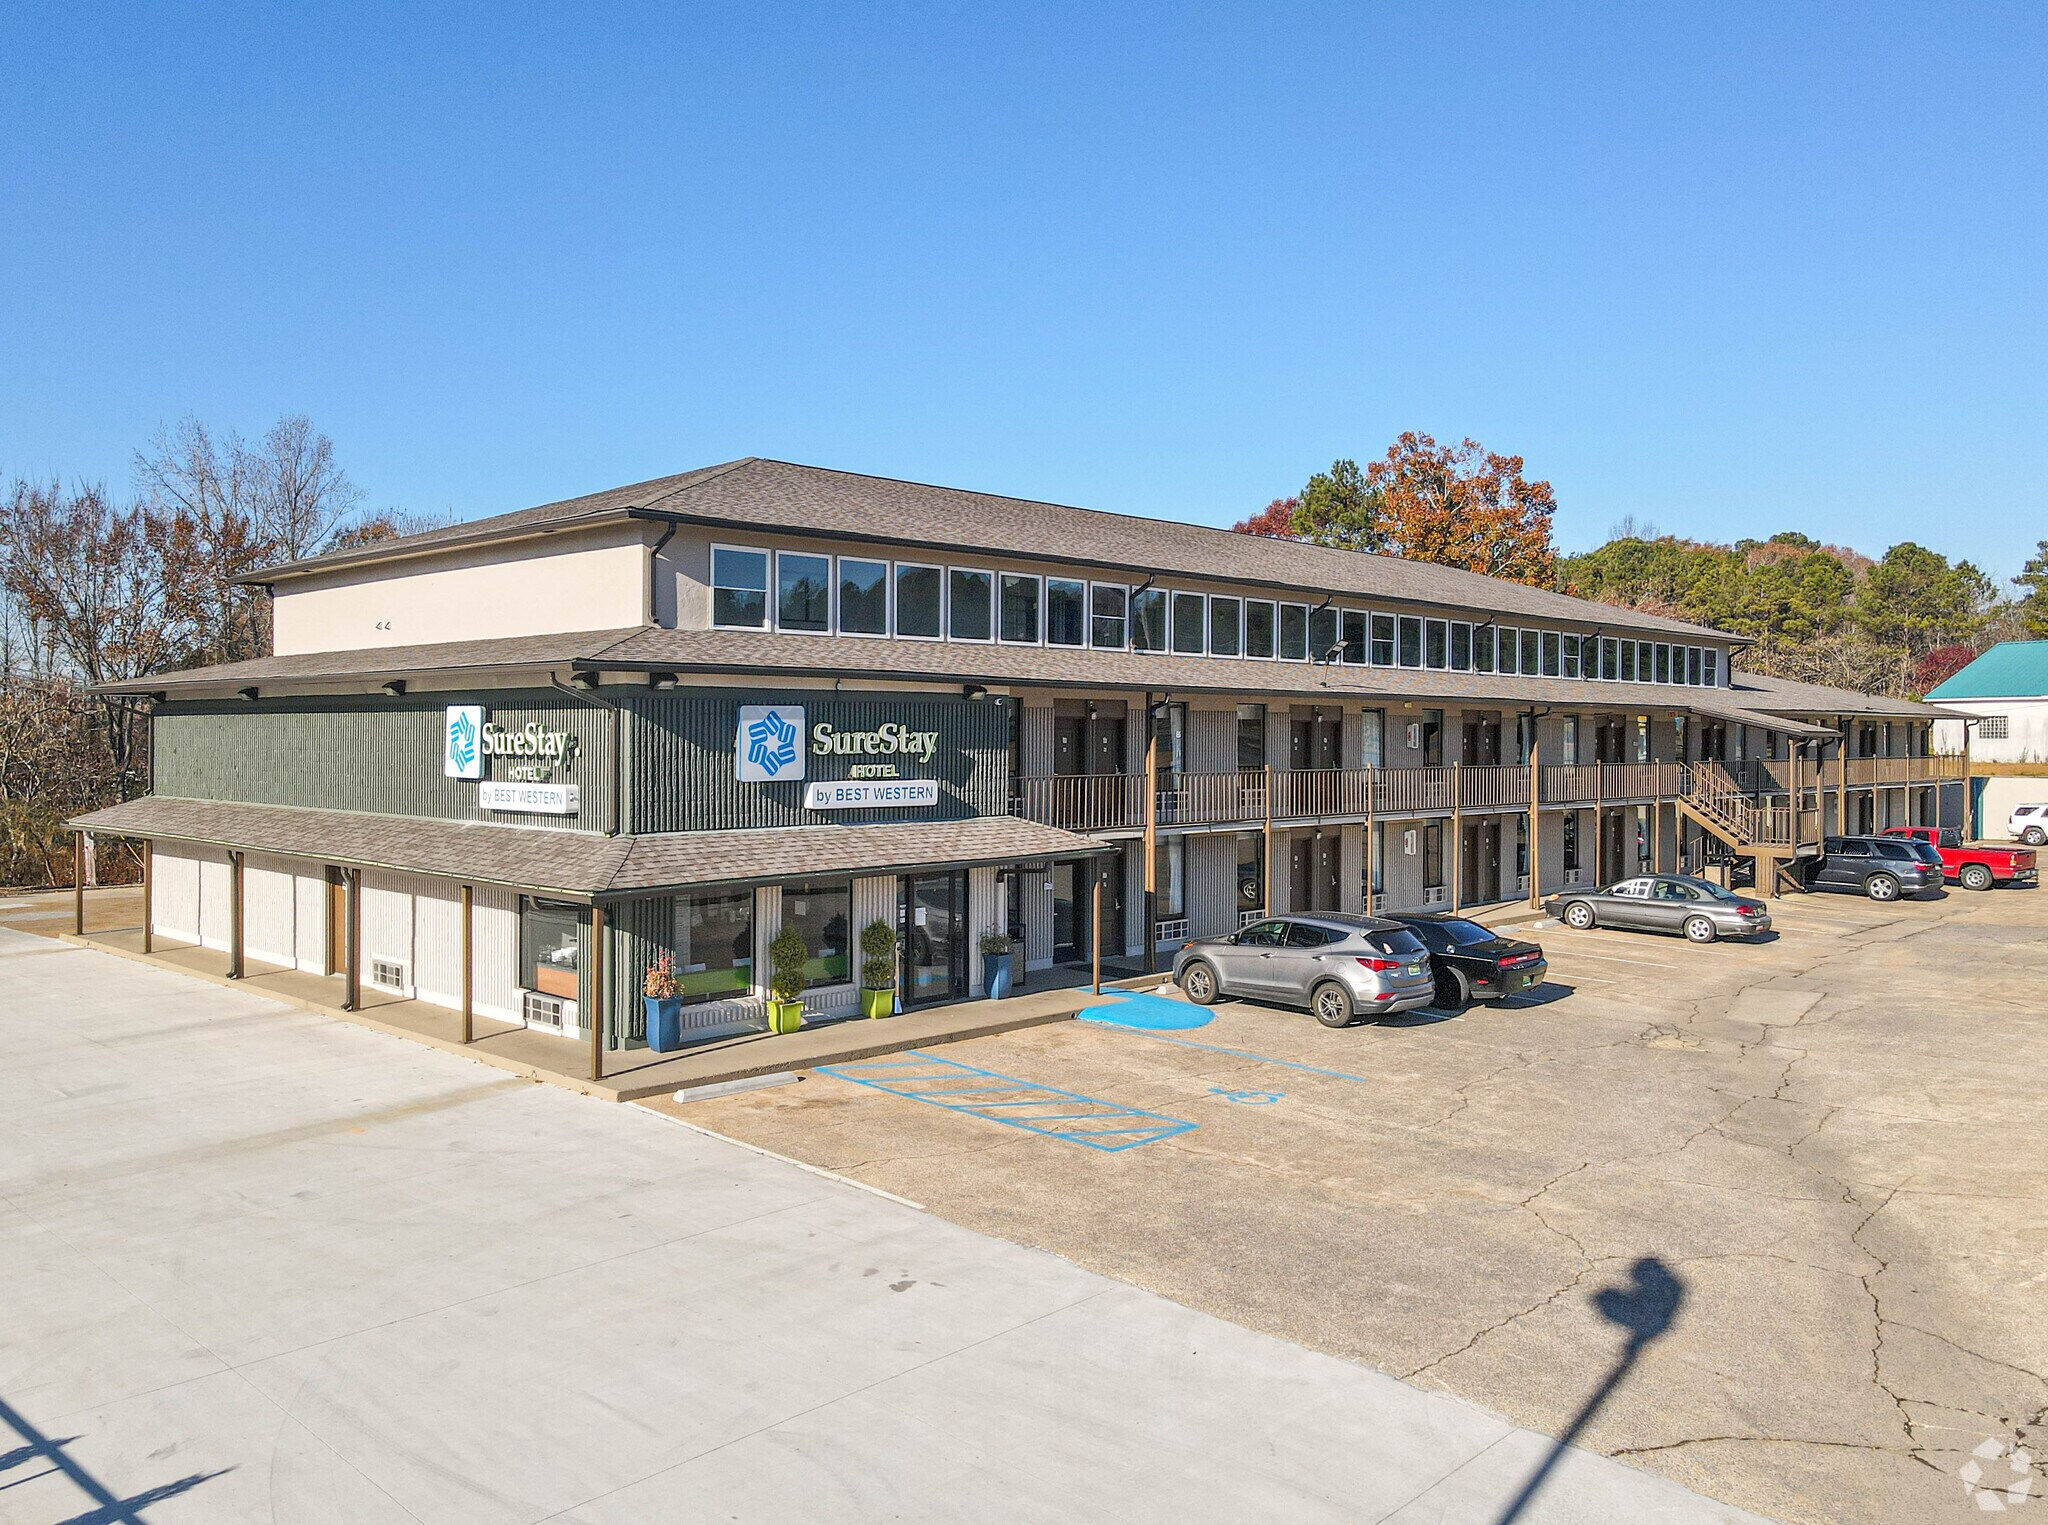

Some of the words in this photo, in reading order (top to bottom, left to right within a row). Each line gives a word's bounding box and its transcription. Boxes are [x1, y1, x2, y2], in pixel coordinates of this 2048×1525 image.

[482, 722, 567, 766] SureStay
[813, 723, 939, 763] SureStay
[508, 767, 540, 780] HOTEL
[854, 764, 899, 778] HOTEL
[482, 789, 492, 804] by
[494, 789, 516, 802] BEST
[519, 790, 562, 805] WESTERN
[816, 789, 832, 805] by
[836, 787, 869, 801] BEST
[873, 786, 933, 800] WESTERN
